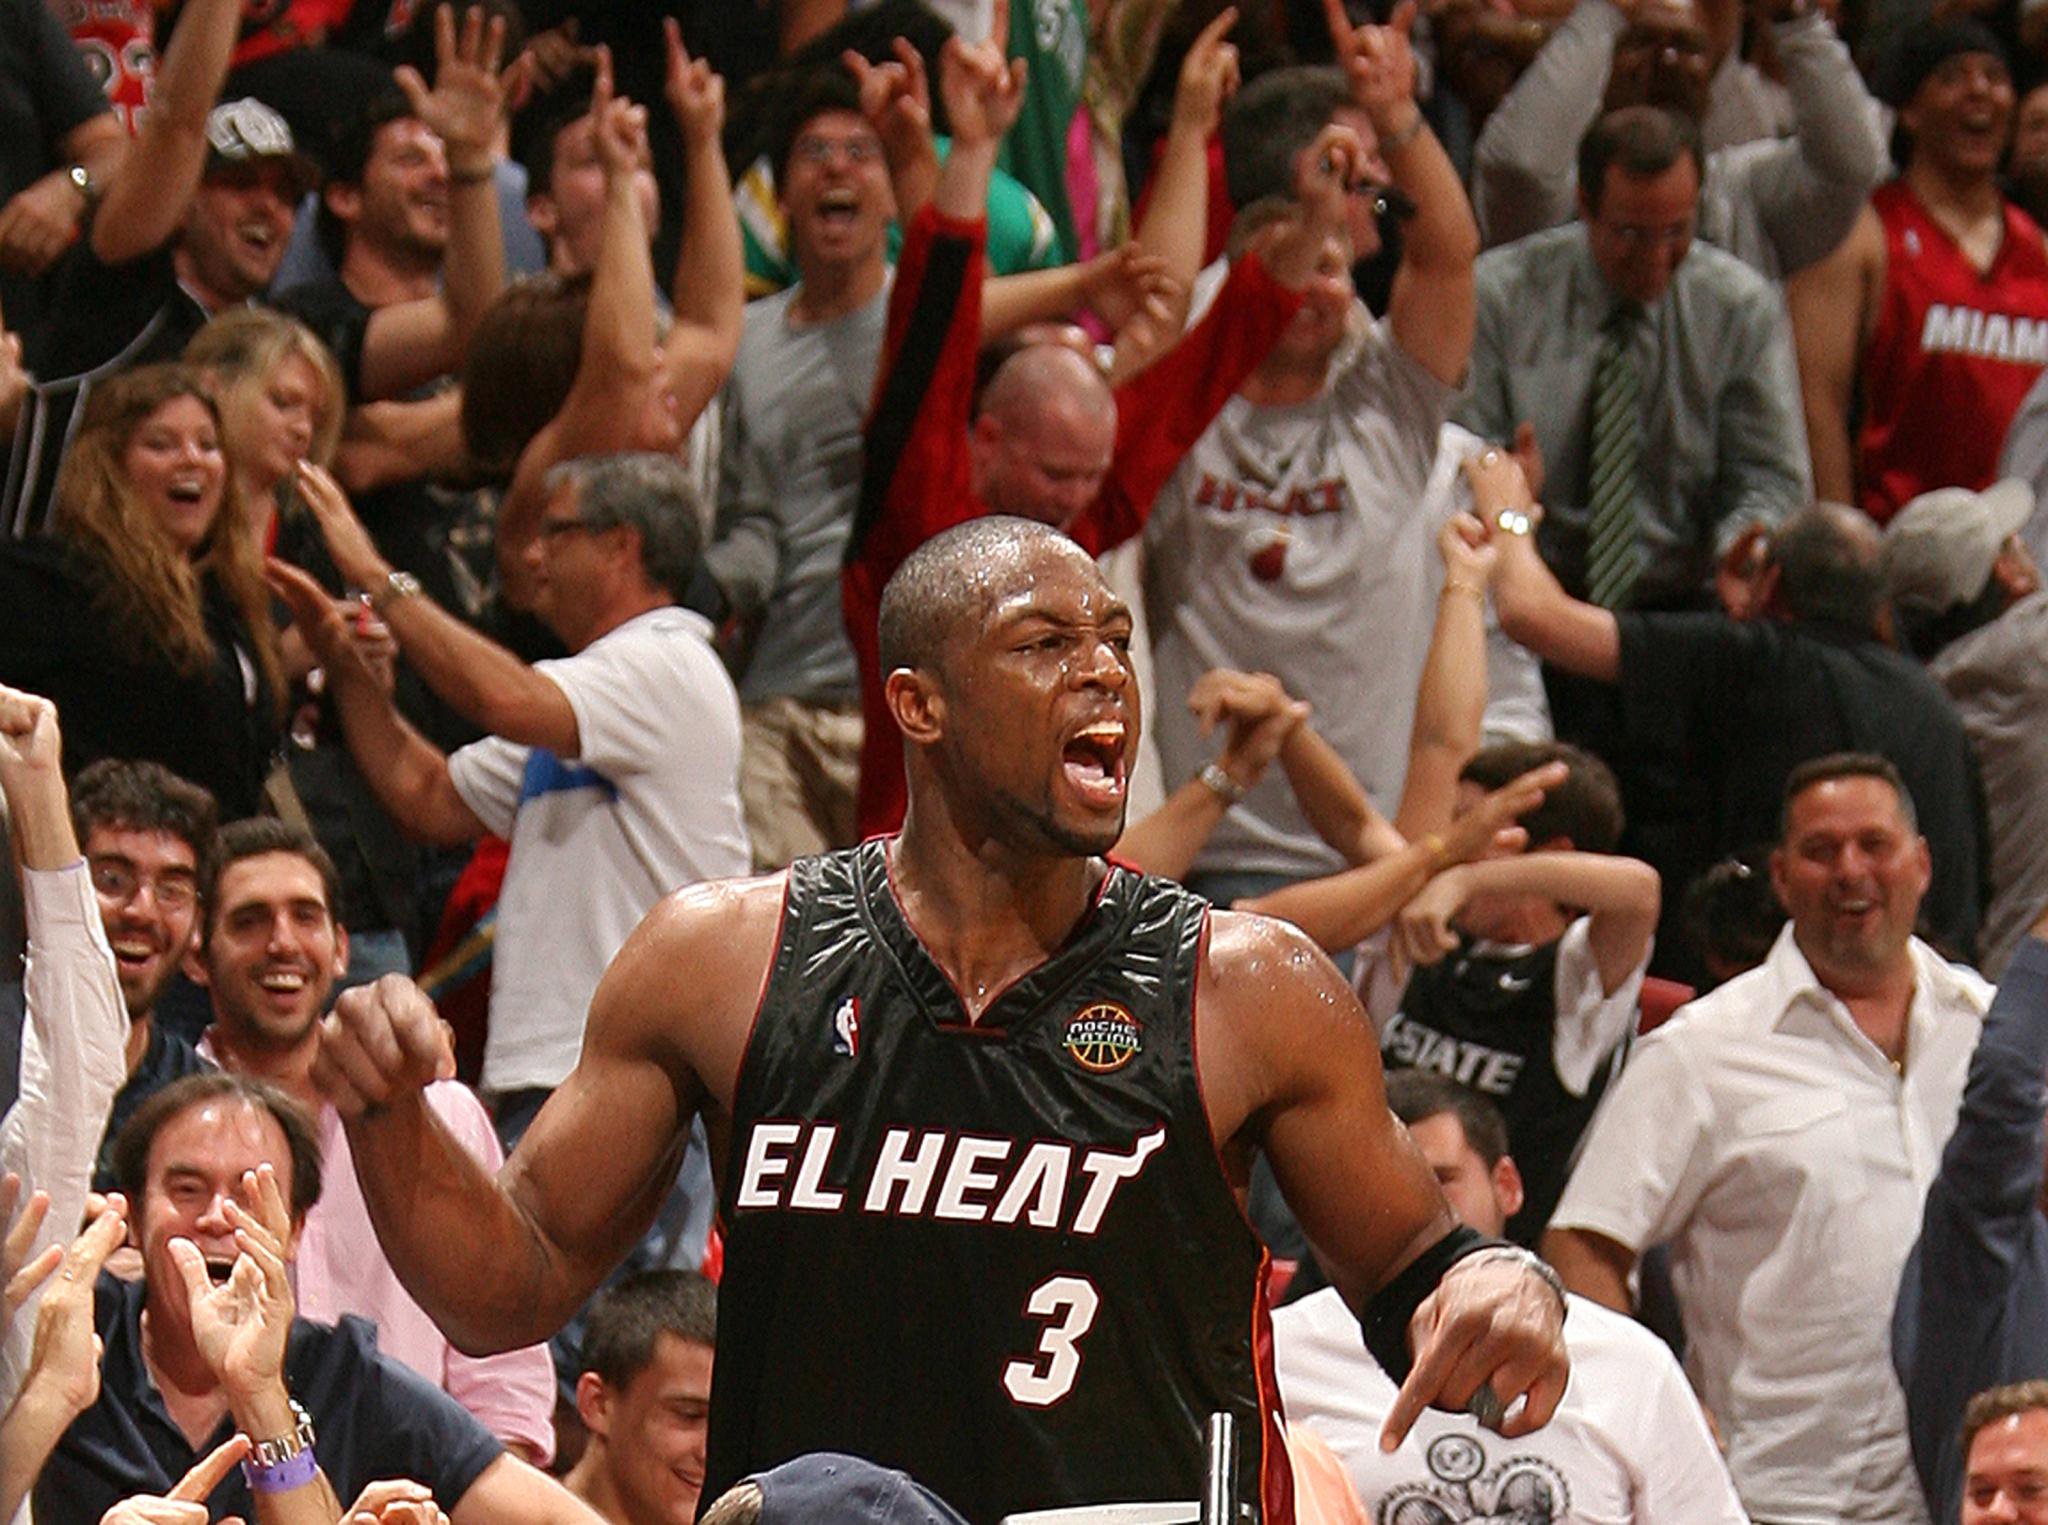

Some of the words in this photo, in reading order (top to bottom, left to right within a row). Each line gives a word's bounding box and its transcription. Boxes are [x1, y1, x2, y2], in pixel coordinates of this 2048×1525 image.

[736, 1123, 845, 1211] EL
[863, 1127, 1166, 1235] HEAT
[1003, 1275, 1099, 1406] 3
